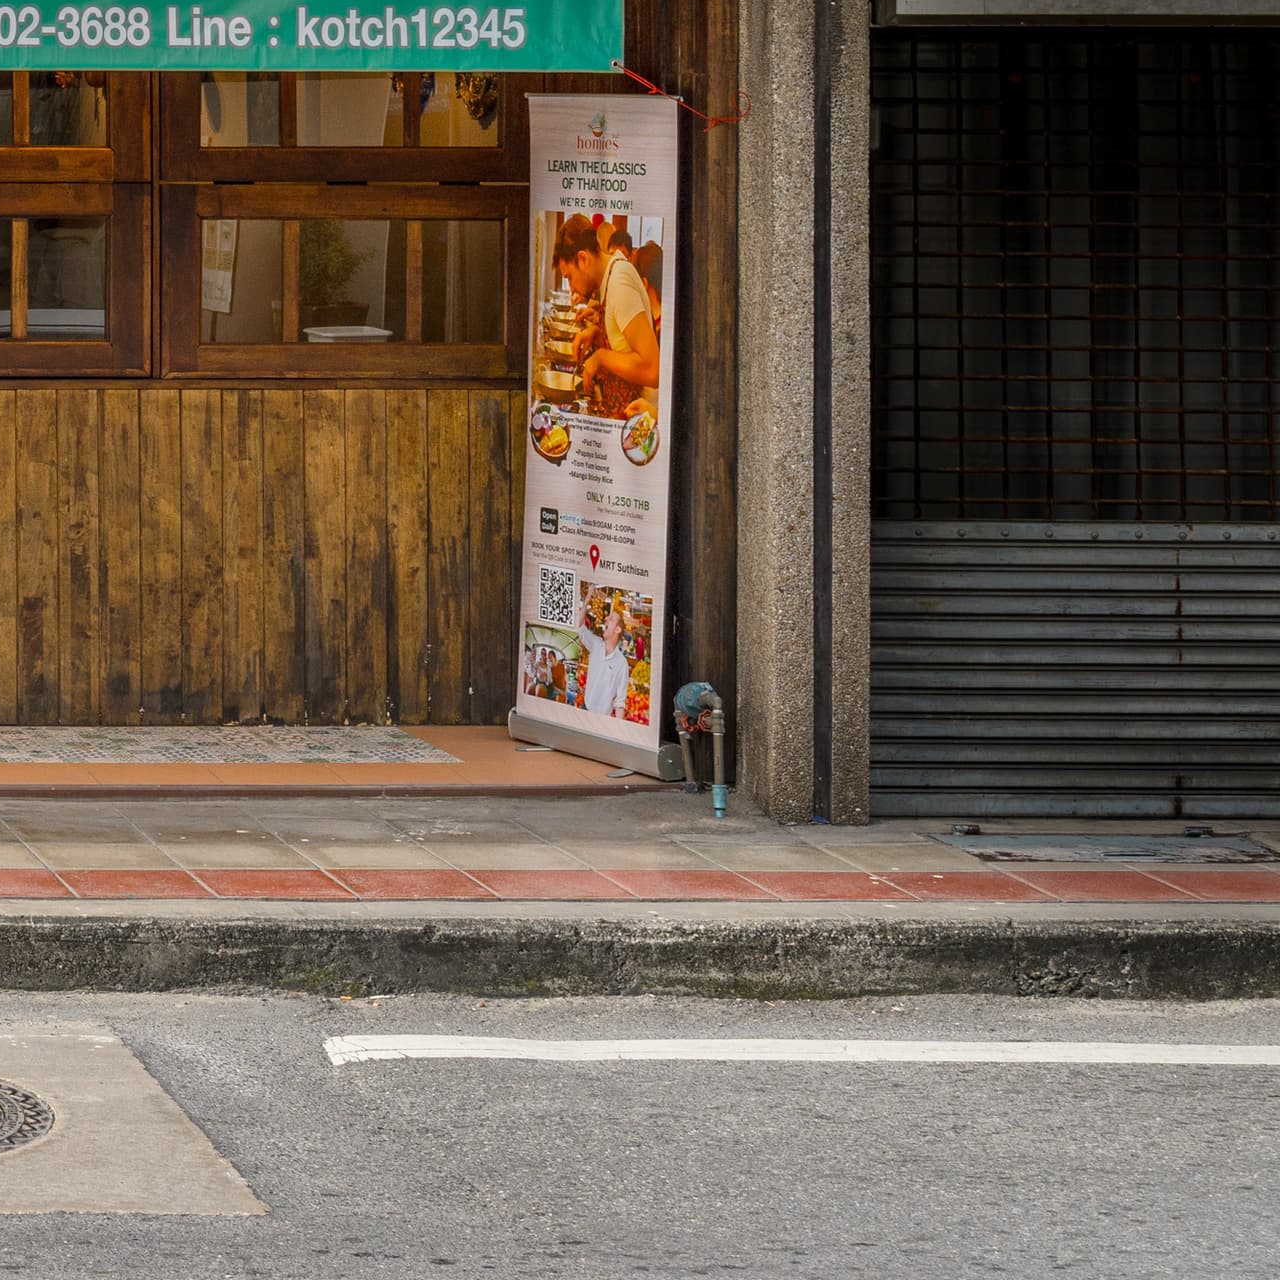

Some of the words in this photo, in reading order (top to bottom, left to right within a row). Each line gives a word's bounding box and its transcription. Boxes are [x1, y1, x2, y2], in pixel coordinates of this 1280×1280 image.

[167, 5, 253, 48] Line
[268, 15, 280, 48] :
[296, 6, 527, 49] kotch12345
[576, 135, 619, 150] homies
[547, 159, 577, 173] LEARN
[580, 161, 600, 174] THE
[600, 162, 647, 176] CLASSICS
[561, 176, 574, 190] OF
[577, 177, 599, 191] THAI
[600, 178, 628, 192] FOOD
[588, 198, 608, 209] OPEN
[610, 199, 633, 210] NOW!
[586, 491, 604, 503] ONLY
[608, 495, 632, 507] 1,250
[633, 499, 650, 511] THB
[599, 559, 616, 571] MRT
[617, 562, 649, 577] Suthisan
